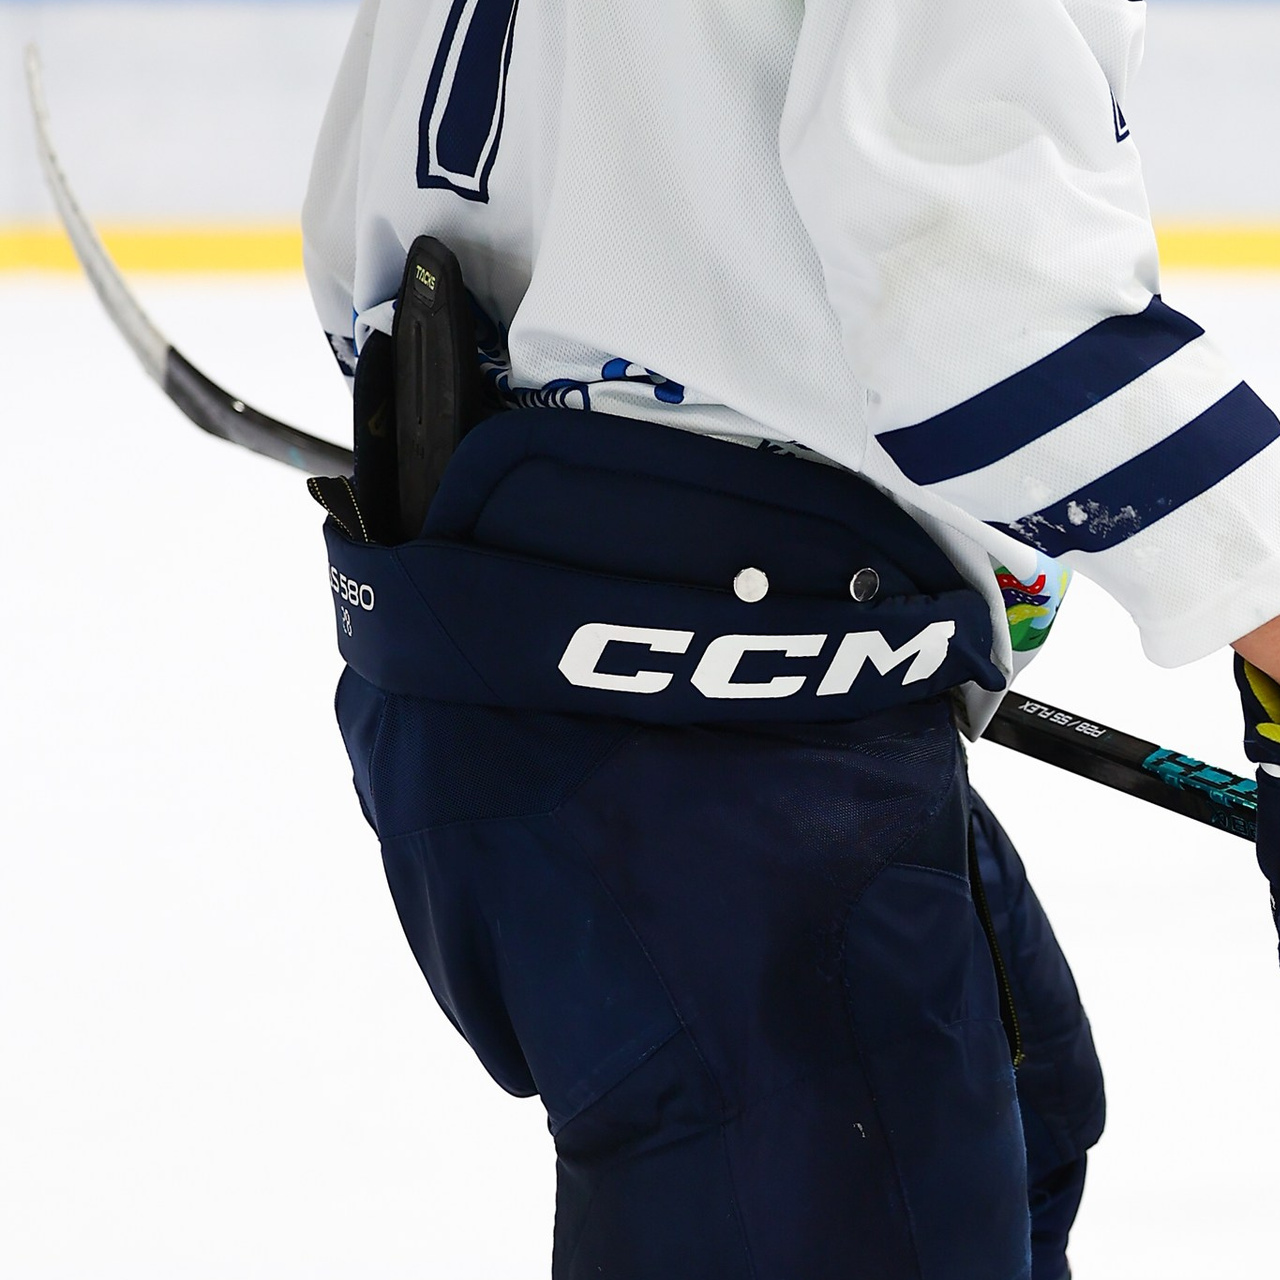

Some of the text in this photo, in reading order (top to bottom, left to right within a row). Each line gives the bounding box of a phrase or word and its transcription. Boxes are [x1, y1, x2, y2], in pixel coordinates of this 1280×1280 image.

[416, 265, 436, 290] TACKS
[557, 621, 956, 699] CCM
[1018, 700, 1055, 719] FLEX
